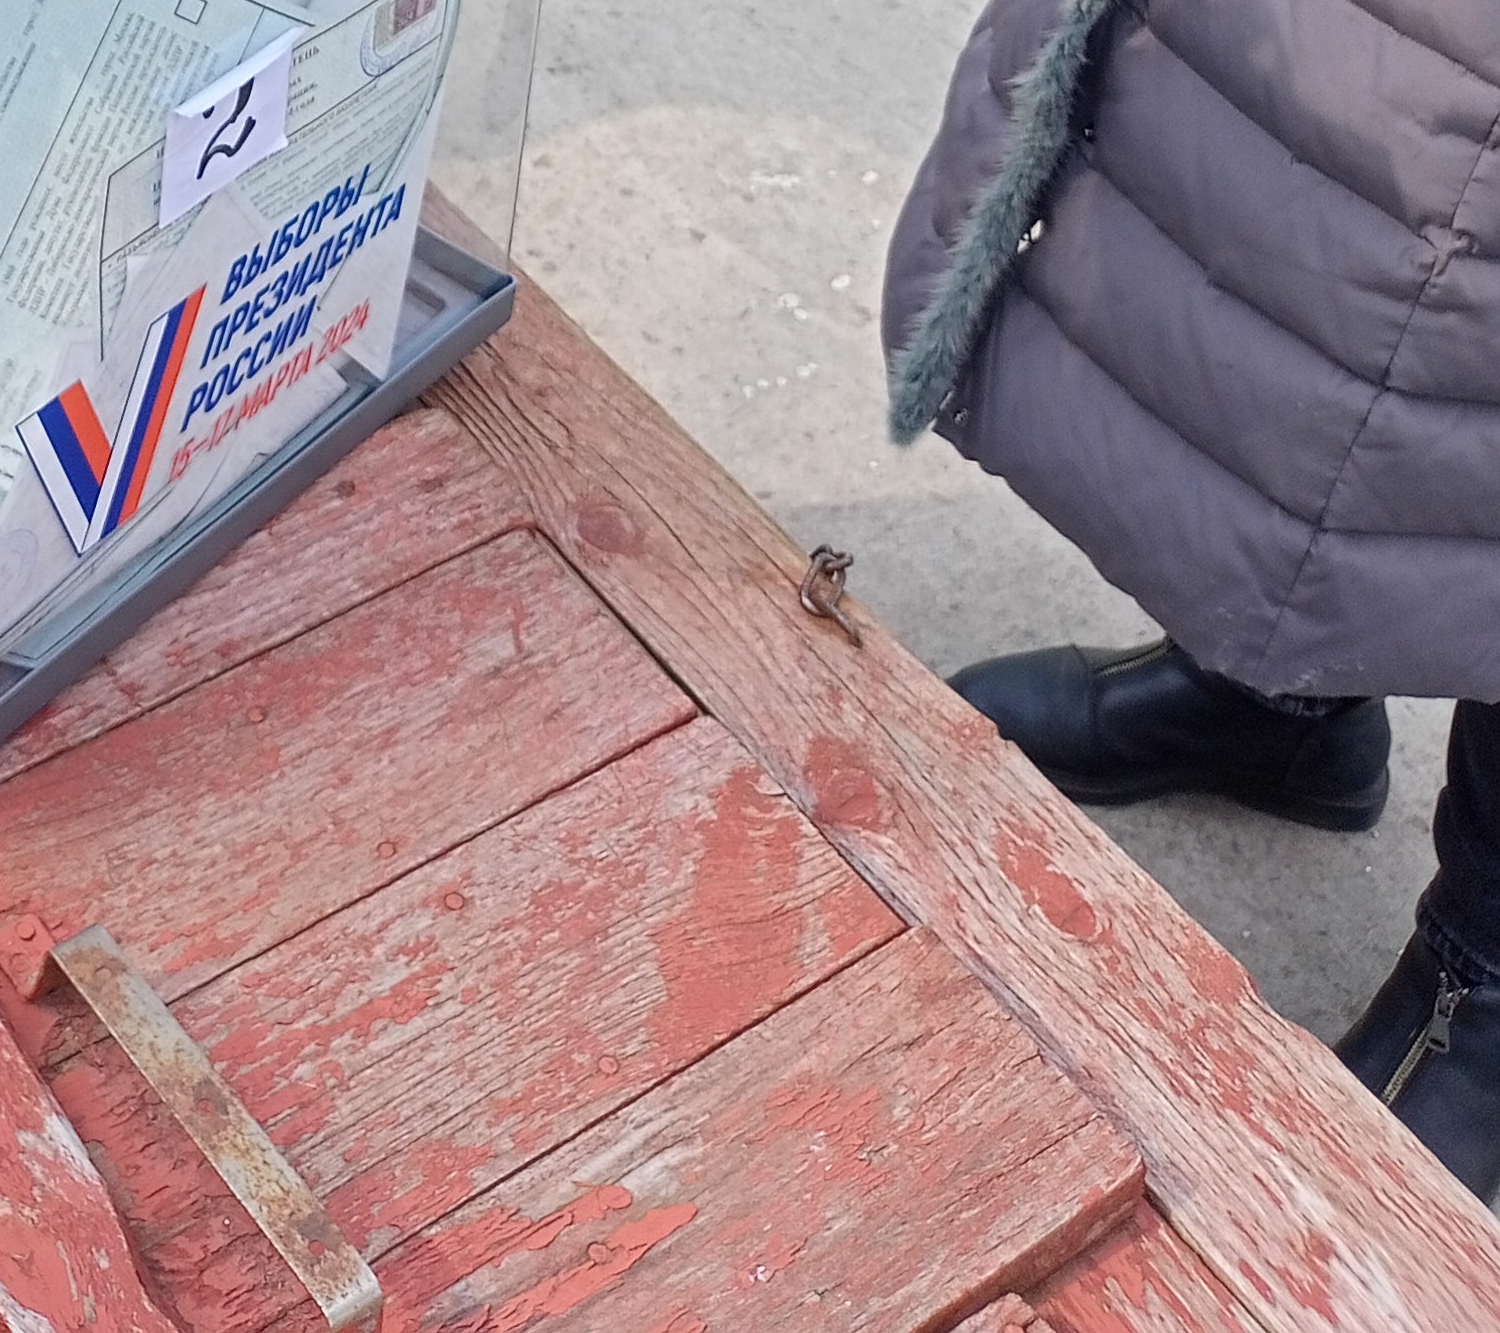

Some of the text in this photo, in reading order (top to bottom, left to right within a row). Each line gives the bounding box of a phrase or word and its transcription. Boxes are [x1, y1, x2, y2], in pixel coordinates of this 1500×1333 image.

[200, 183, 406, 369] ПРЕЗИДЕНТА
[220, 164, 370, 305] ВЫБОРЫ
[180, 295, 317, 433] РОССИИ
[235, 341, 313, 430] МАРТА
[315, 298, 370, 365] 2024
